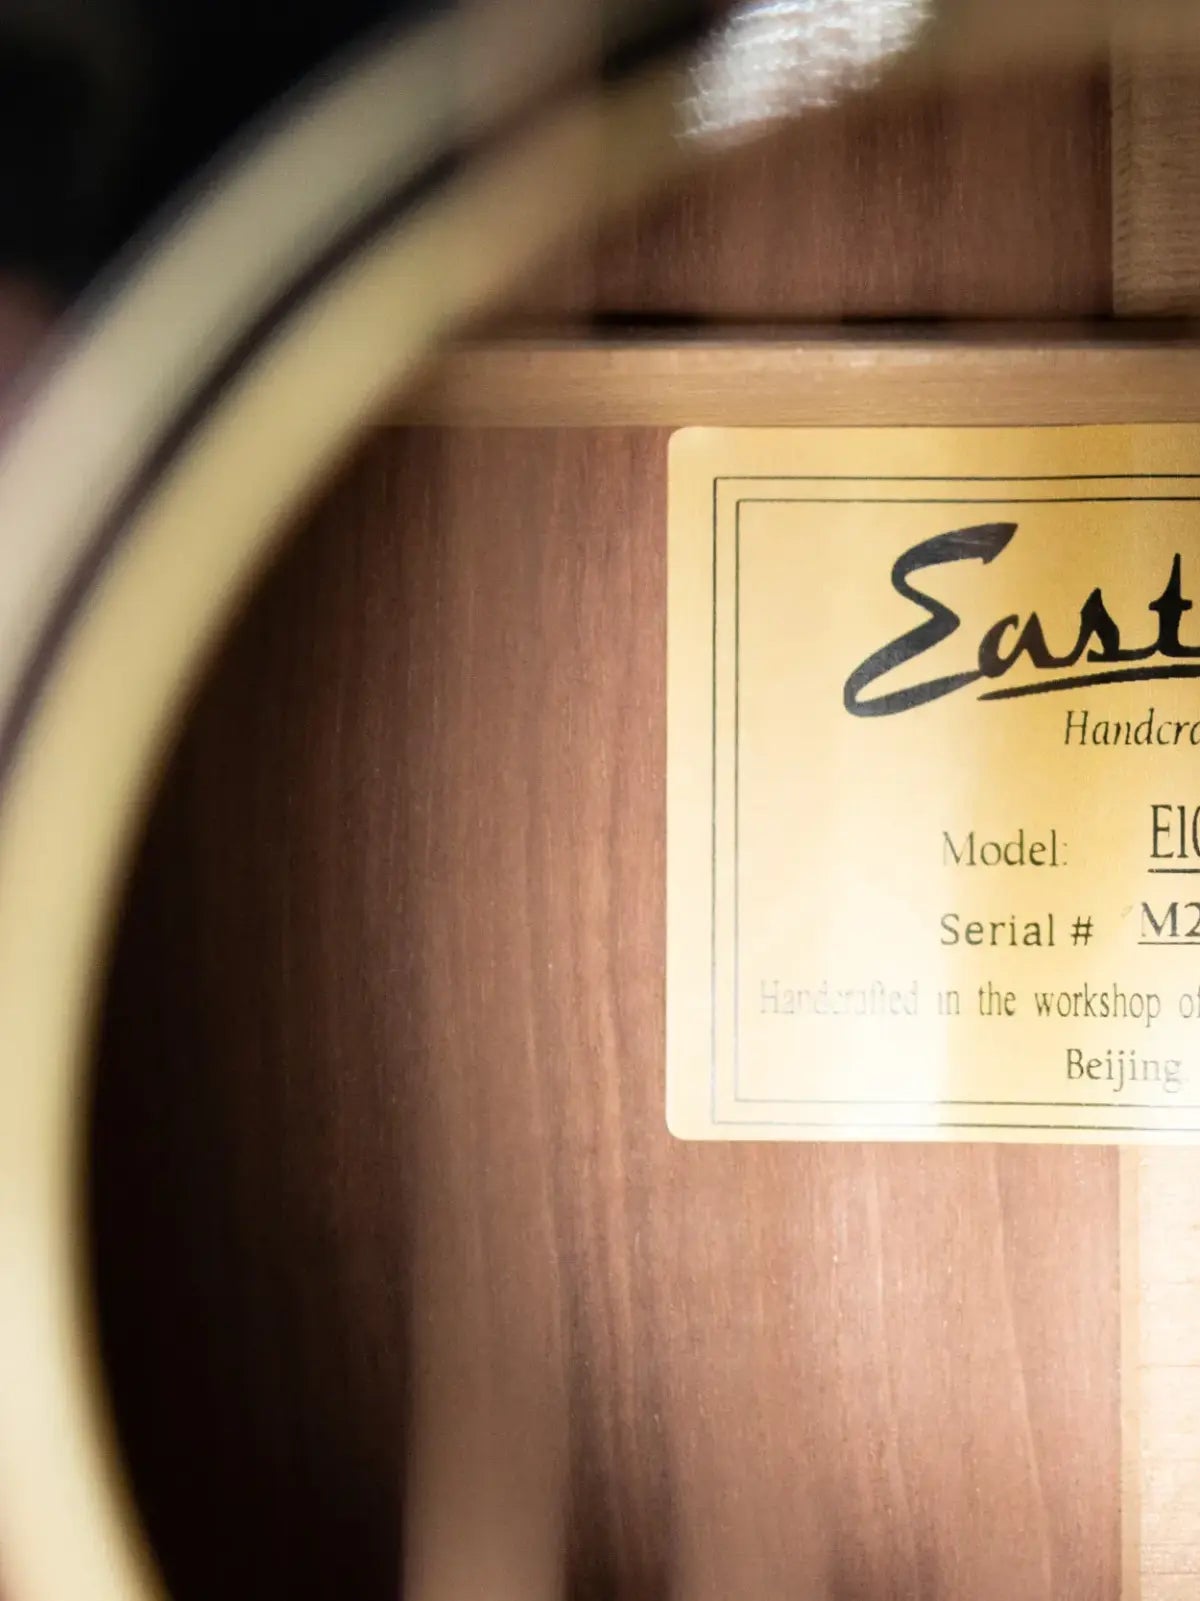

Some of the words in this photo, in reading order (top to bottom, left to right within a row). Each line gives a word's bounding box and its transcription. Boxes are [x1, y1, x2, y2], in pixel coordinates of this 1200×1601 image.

[942, 829, 1068, 867] Model:
[940, 912, 1055, 947] Serial
[1072, 916, 1094, 947] #
[938, 985, 961, 1016] in
[978, 981, 1017, 1016] the
[1034, 983, 1161, 1027] workshop
